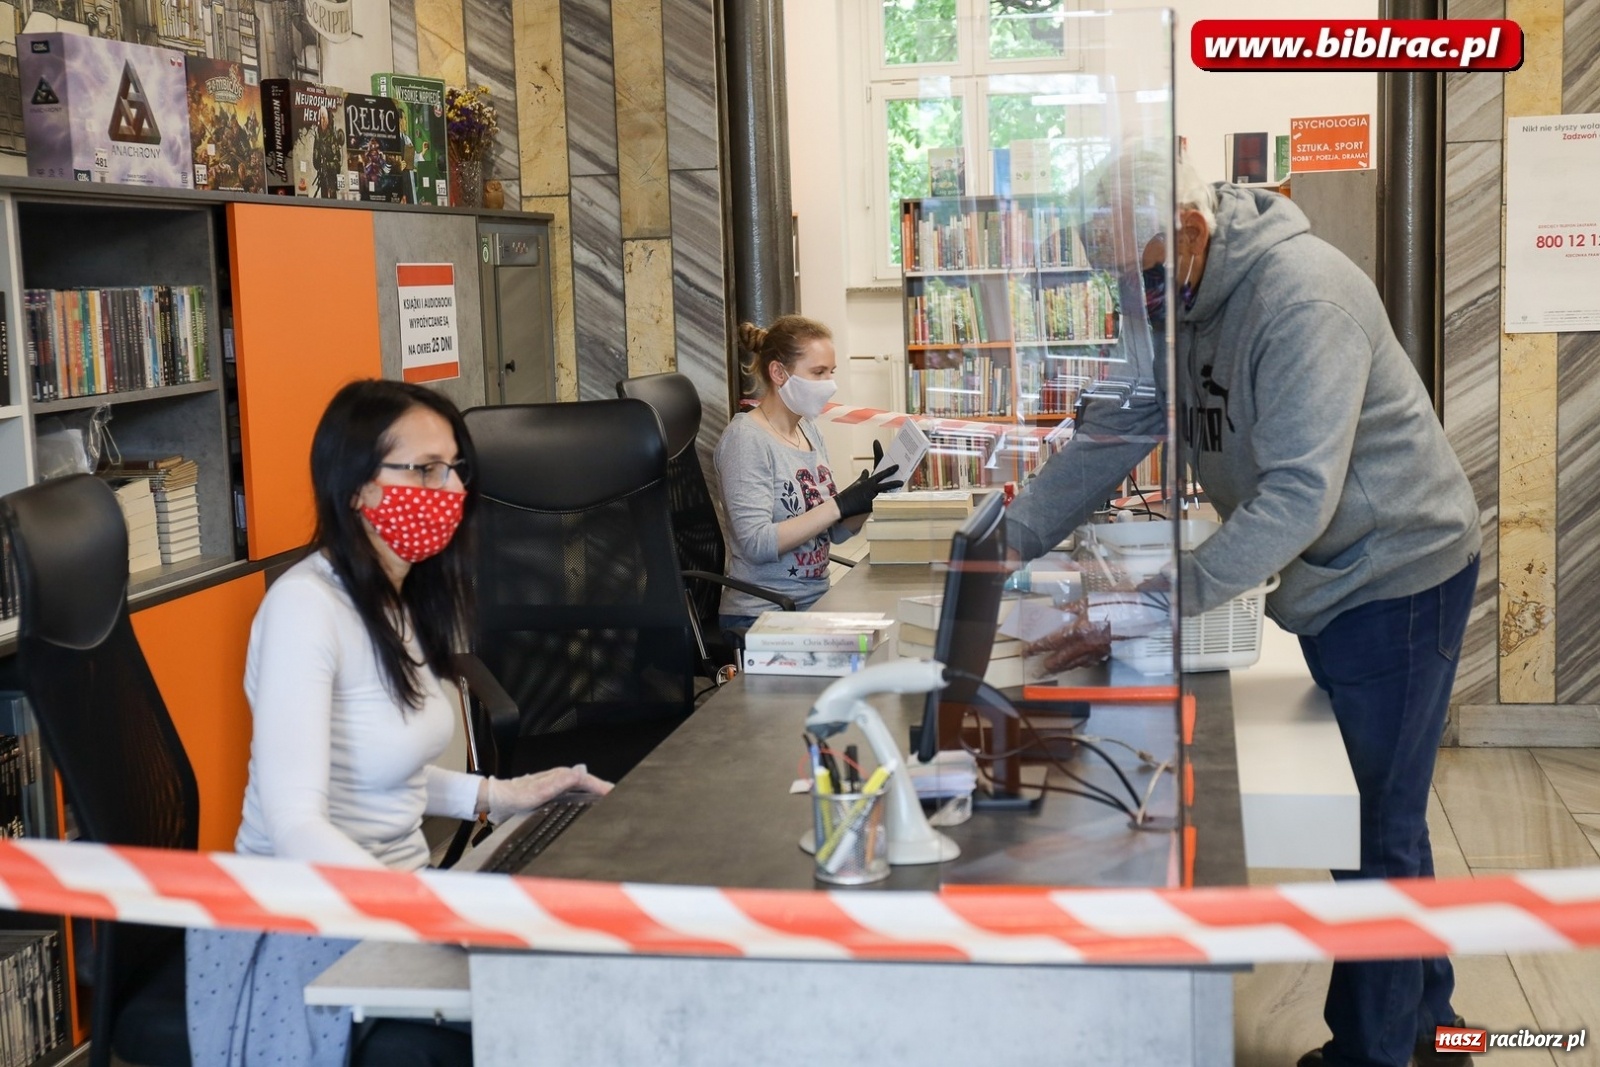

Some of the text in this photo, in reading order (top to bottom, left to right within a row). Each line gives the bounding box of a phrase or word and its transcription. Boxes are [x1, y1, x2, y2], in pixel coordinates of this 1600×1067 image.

[295, 92, 337, 110] NEUROSHIMA
[304, 108, 320, 125] HEX!
[346, 104, 396, 136] RELIC
[1292, 117, 1368, 130] PSYCHOLOGIA
[272, 99, 283, 151] NEUROSHIMA
[1554, 123, 1577, 132] słyszy
[1562, 131, 1597, 140] Zadzwoń
[112, 145, 161, 158] ANACHRONY
[1296, 141, 1364, 153] SZTUKA, SPORT
[95, 158, 108, 168] 481
[1536, 233, 1600, 248] 800 12 1
[403, 296, 420, 311] KSIĄŻKI
[424, 297, 452, 308] AUDIOBOOKI
[409, 315, 450, 329] WYPOŻYCZANE SĄ
[408, 336, 452, 356] NA OKRES 25 DNI
